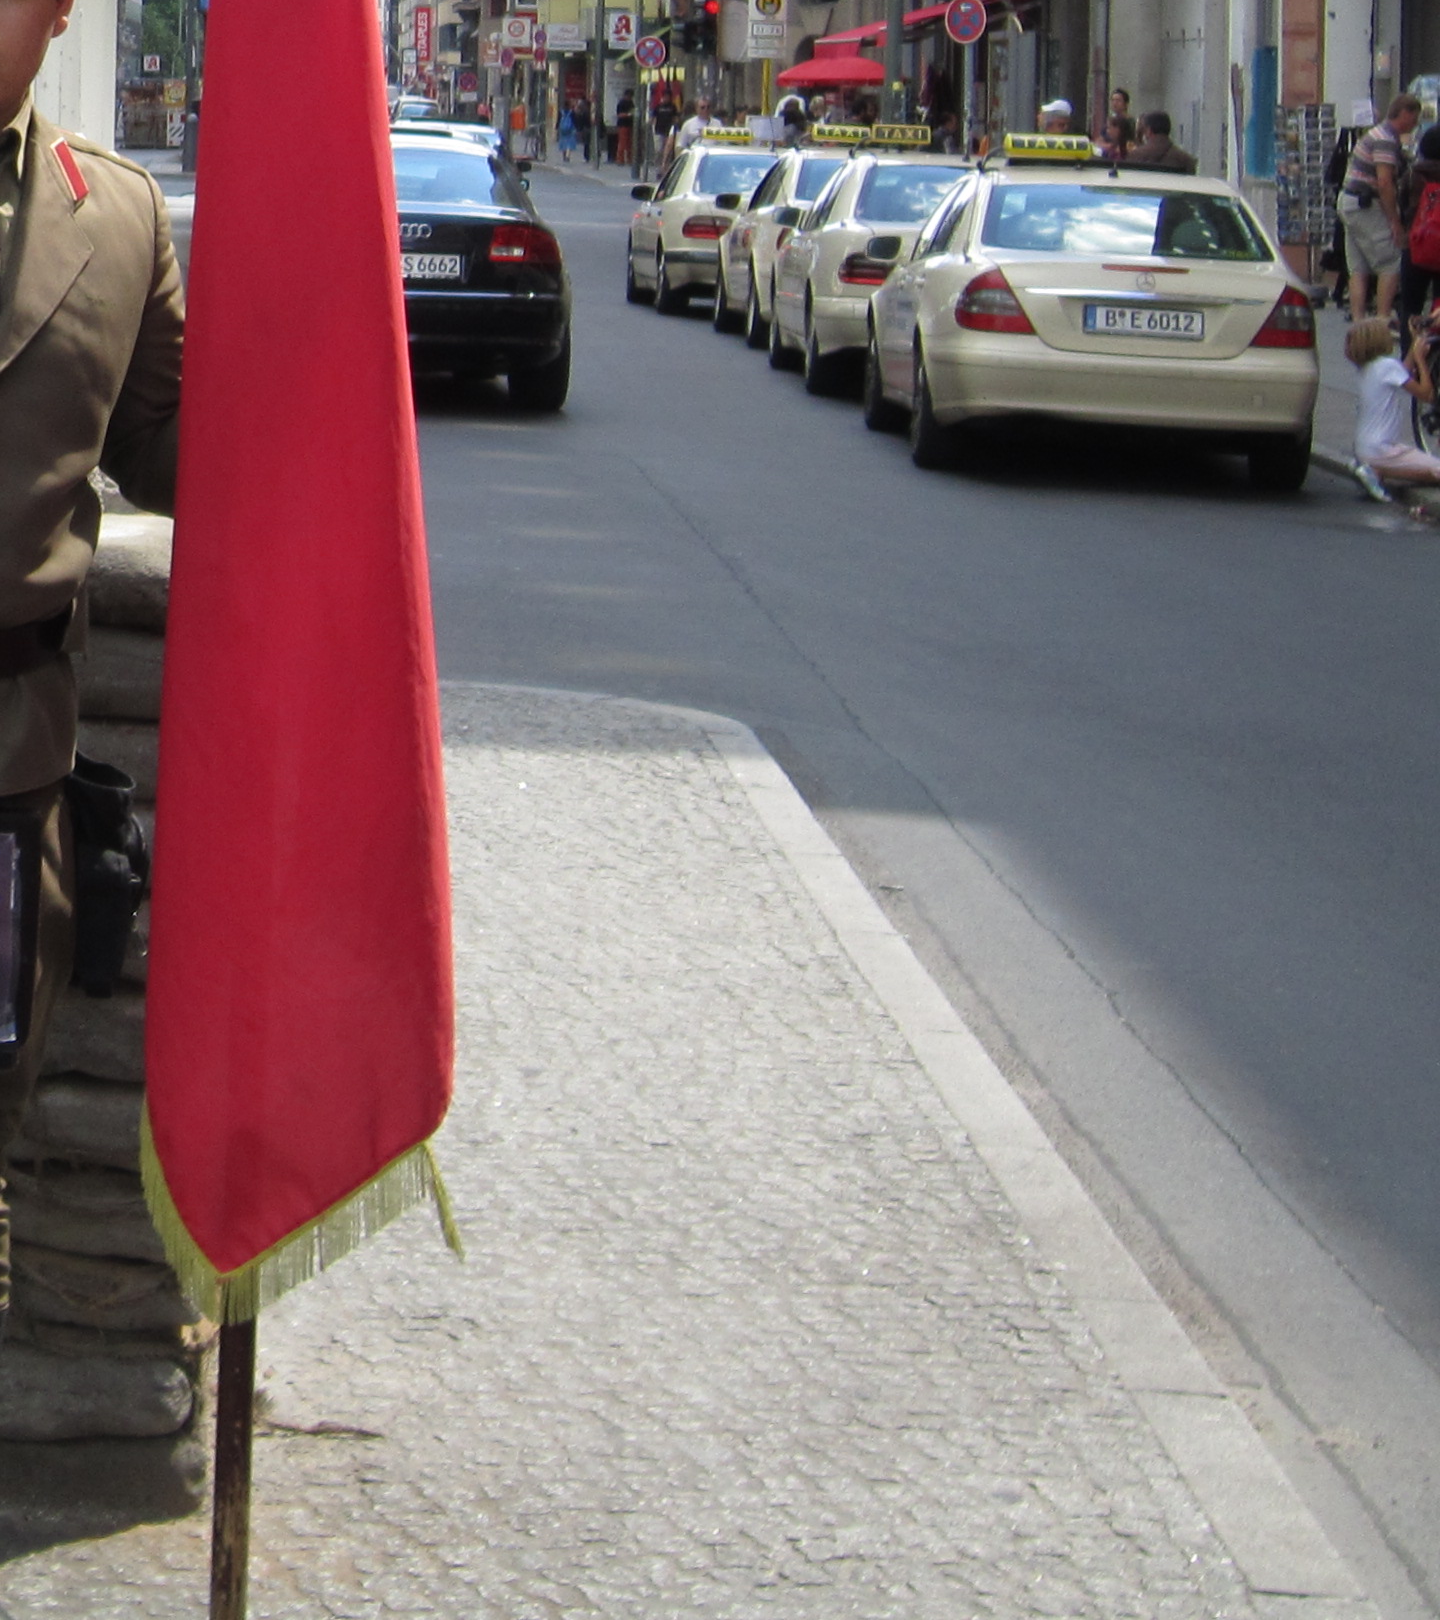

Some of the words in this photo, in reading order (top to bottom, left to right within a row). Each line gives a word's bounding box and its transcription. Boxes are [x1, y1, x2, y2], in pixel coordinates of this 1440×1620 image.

[418, 11, 428, 58] STAPLES
[823, 128, 867, 138] TAXI
[883, 127, 924, 140] TAXI
[1023, 136, 1078, 150] TAXI
[418, 256, 458, 274] 6662
[1147, 310, 1195, 333] 6012
